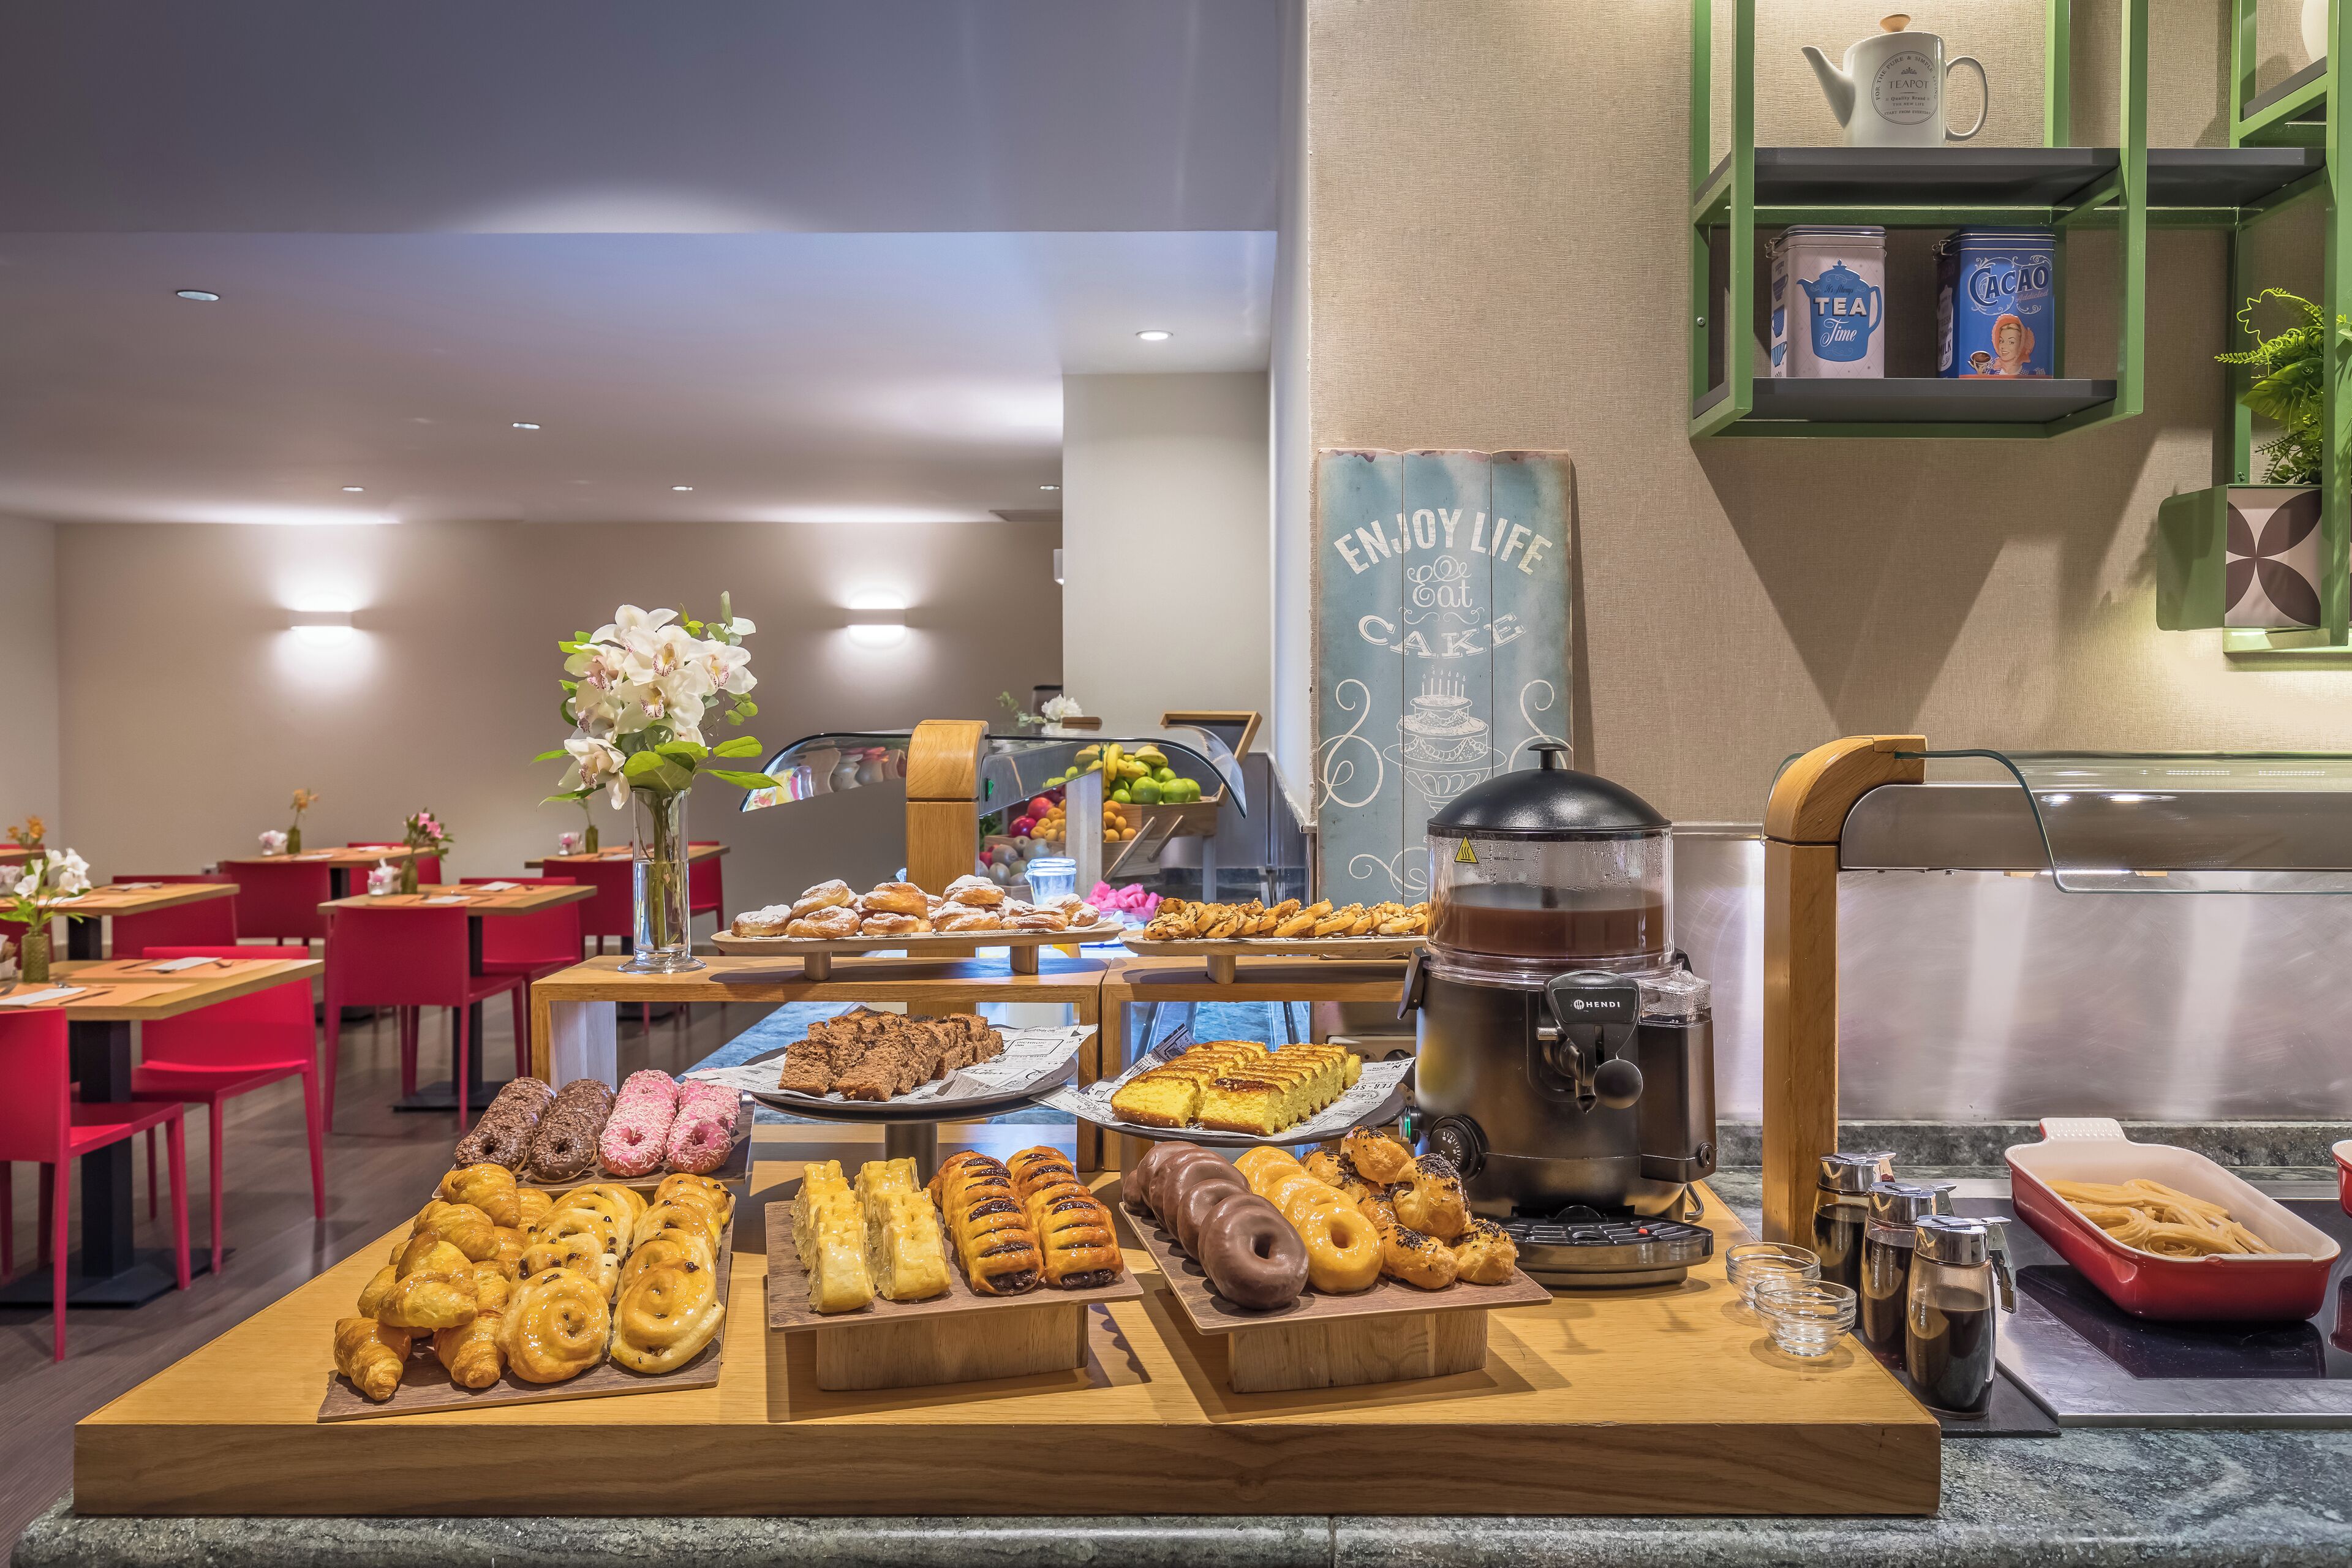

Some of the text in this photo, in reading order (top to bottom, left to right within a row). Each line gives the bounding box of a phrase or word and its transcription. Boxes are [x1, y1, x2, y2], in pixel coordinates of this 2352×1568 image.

[1877, 70, 1887, 83] THE
[1886, 56, 1904, 69] PURE
[1915, 56, 1933, 73] SIMPLE
[1888, 80, 1929, 89] TEAPOT
[1836, 284, 1853, 295] Always
[1969, 266, 2049, 307] CACAO
[2015, 289, 2049, 303] Addicted
[1814, 297, 1867, 317] TEA
[1820, 318, 1857, 347] Time
[1939, 339, 1952, 356] MILK
[1333, 508, 1553, 576] ENJOY LIFE
[1407, 555, 1472, 608] Eat
[1358, 612, 1526, 658] CAKE
